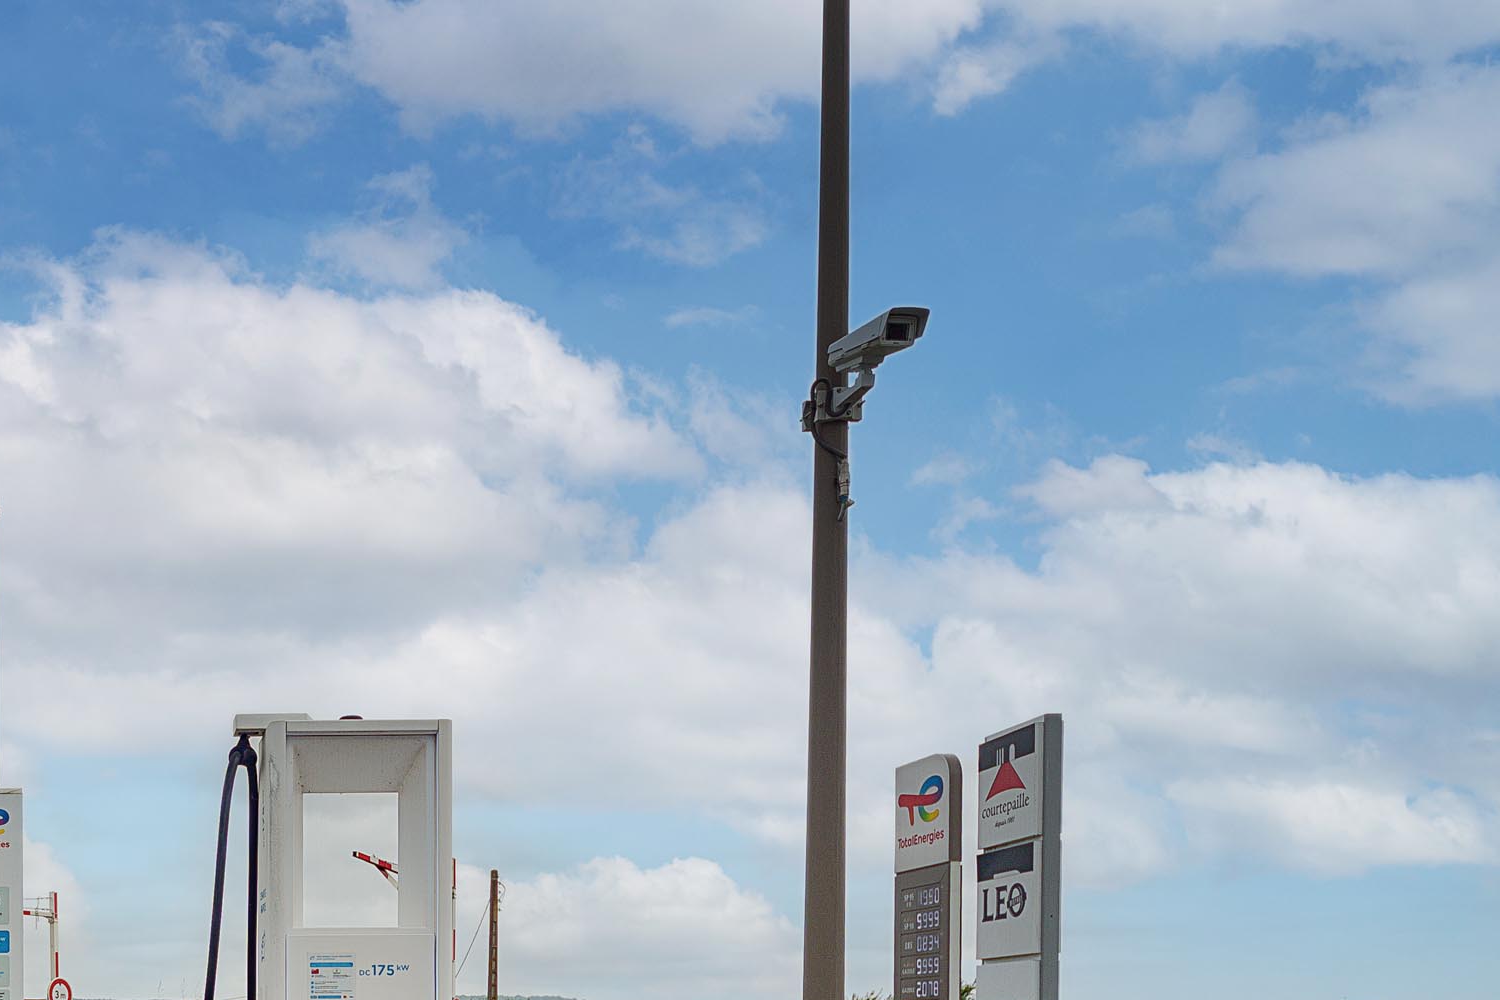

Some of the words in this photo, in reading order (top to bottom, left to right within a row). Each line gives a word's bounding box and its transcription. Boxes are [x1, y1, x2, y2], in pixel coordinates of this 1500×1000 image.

[982, 792, 1029, 819] courtepaille
[898, 829, 944, 849] TotalEnergies
[982, 882, 1027, 922] LEO
[371, 964, 395, 976] 175
[55, 990, 59, 999] 3
